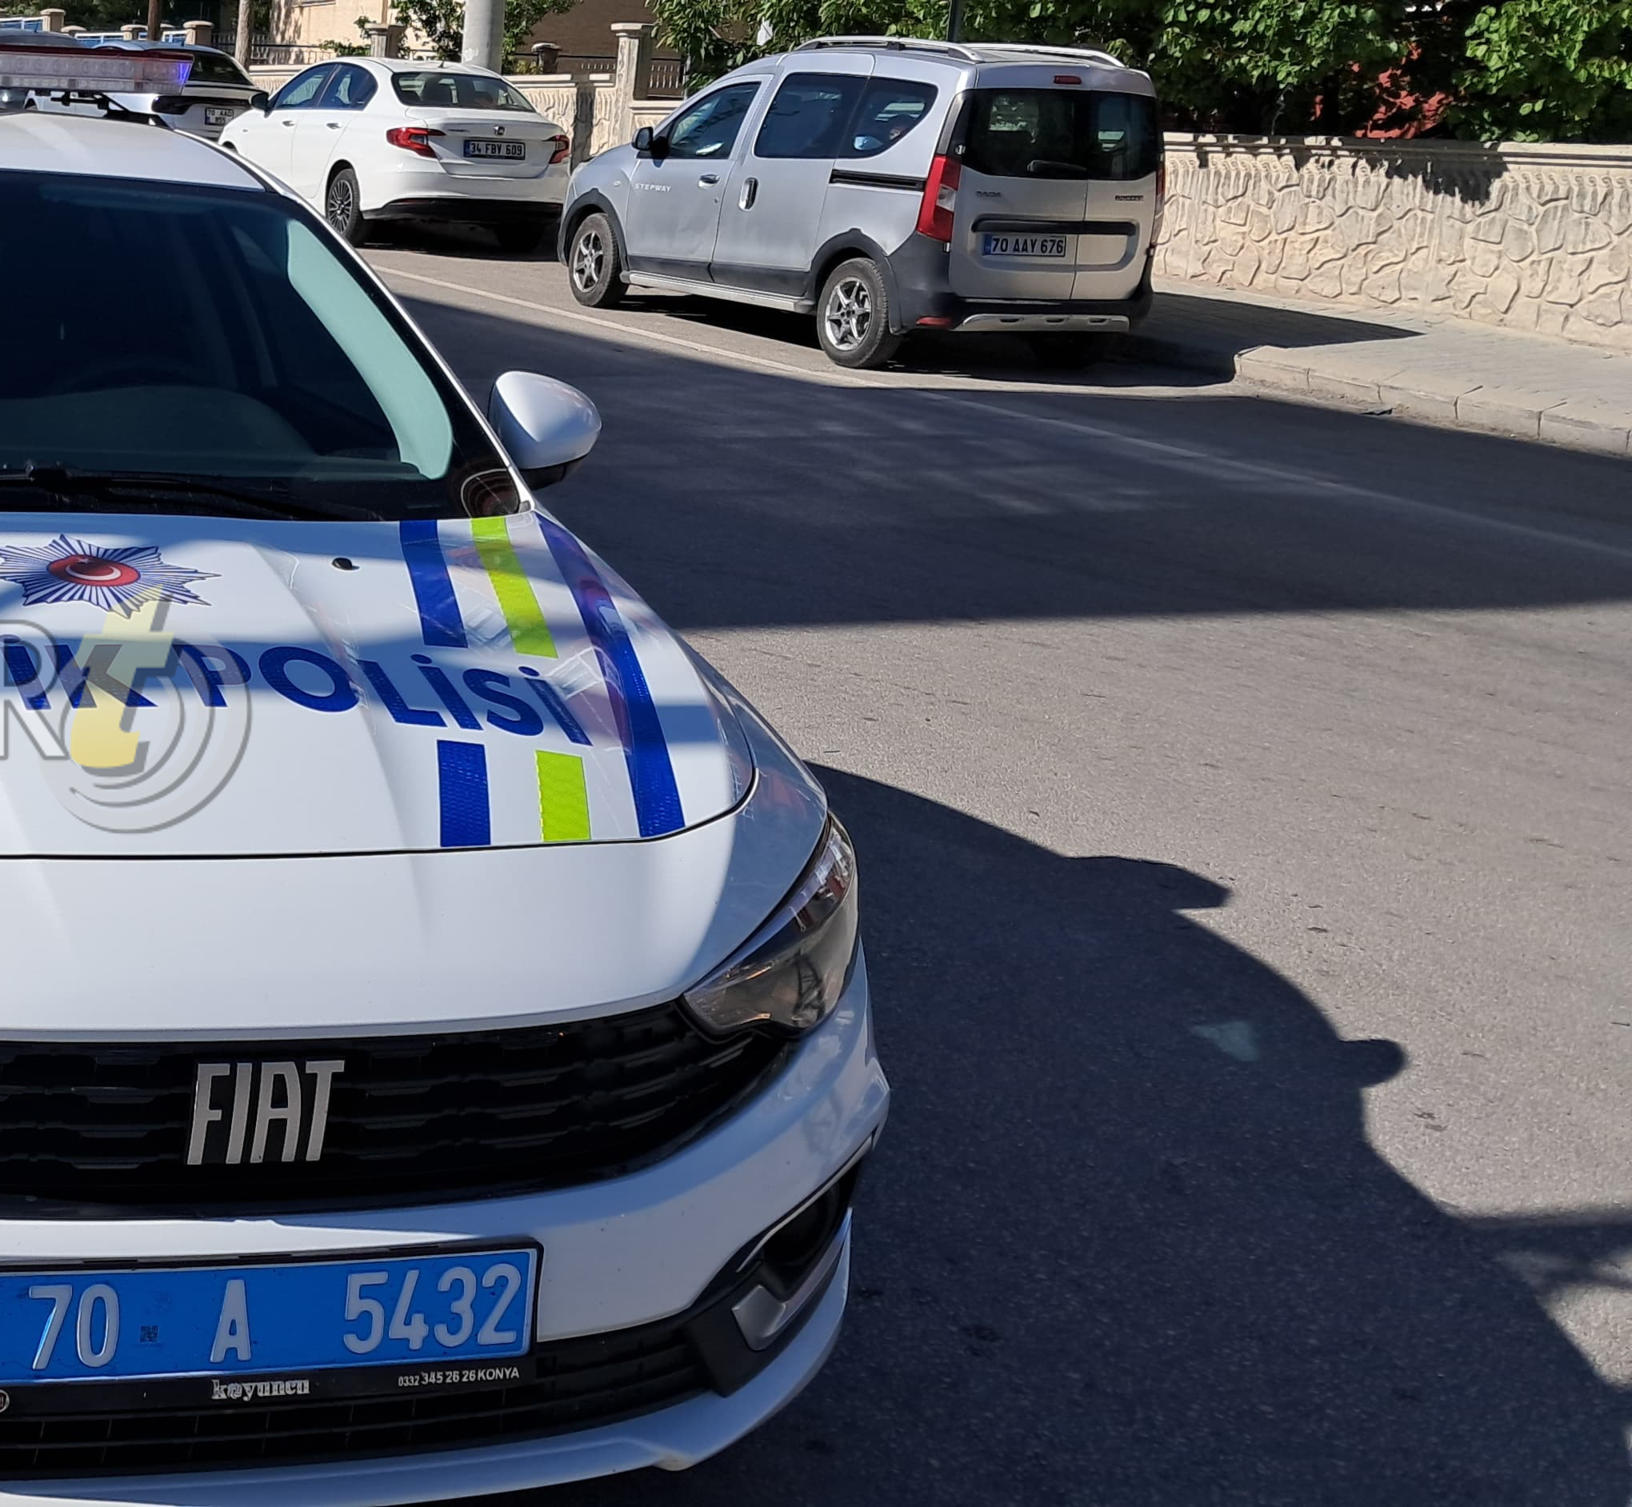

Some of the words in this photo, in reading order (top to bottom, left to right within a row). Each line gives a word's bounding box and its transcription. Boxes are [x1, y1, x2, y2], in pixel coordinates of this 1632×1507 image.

[471, 143, 482, 153] 34
[485, 143, 502, 155] FBV
[505, 144, 523, 156] 609
[992, 238, 1009, 252] 70
[1013, 238, 1037, 253] AAY
[1040, 238, 1064, 254] 676
[171, 644, 593, 746] POLİSİ
[187, 1060, 345, 1165] FIAT
[29, 1283, 120, 1370] 70
[210, 1279, 252, 1363] A
[343, 1263, 522, 1354] 5432
[398, 1375, 420, 1387] 0332
[421, 1371, 444, 1384] 345
[462, 1369, 476, 1382] 26
[477, 1367, 520, 1380] KONYA
